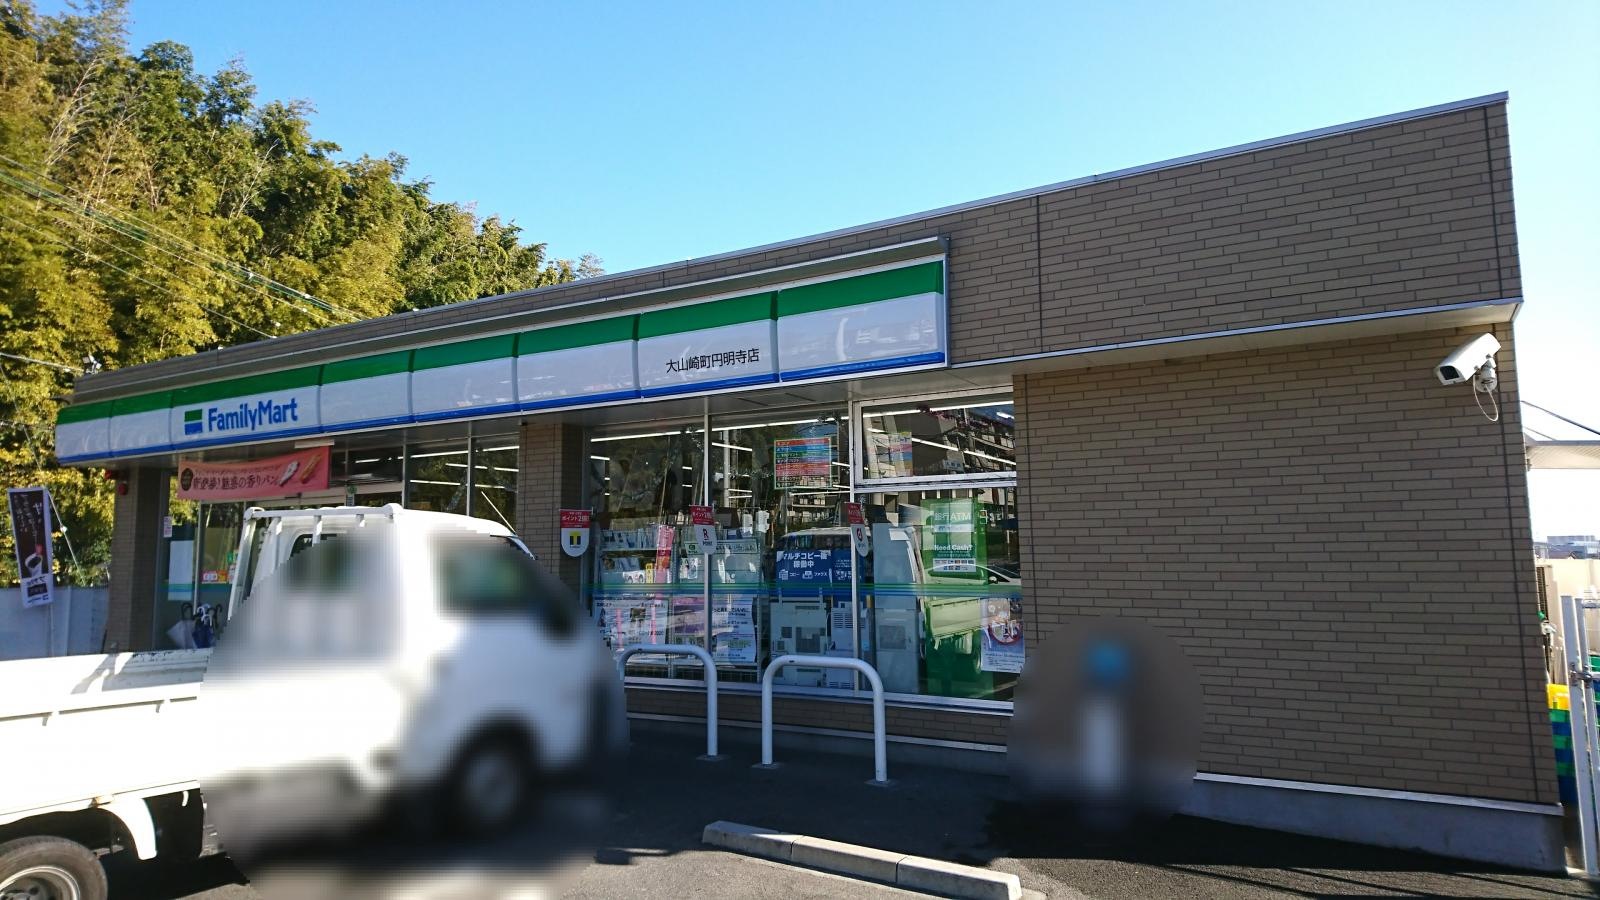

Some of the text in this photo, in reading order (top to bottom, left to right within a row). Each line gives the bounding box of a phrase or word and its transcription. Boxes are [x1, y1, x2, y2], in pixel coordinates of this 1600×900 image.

[665, 347, 760, 373] 大山崎町円明寺店
[208, 398, 298, 432] FamilyMart
